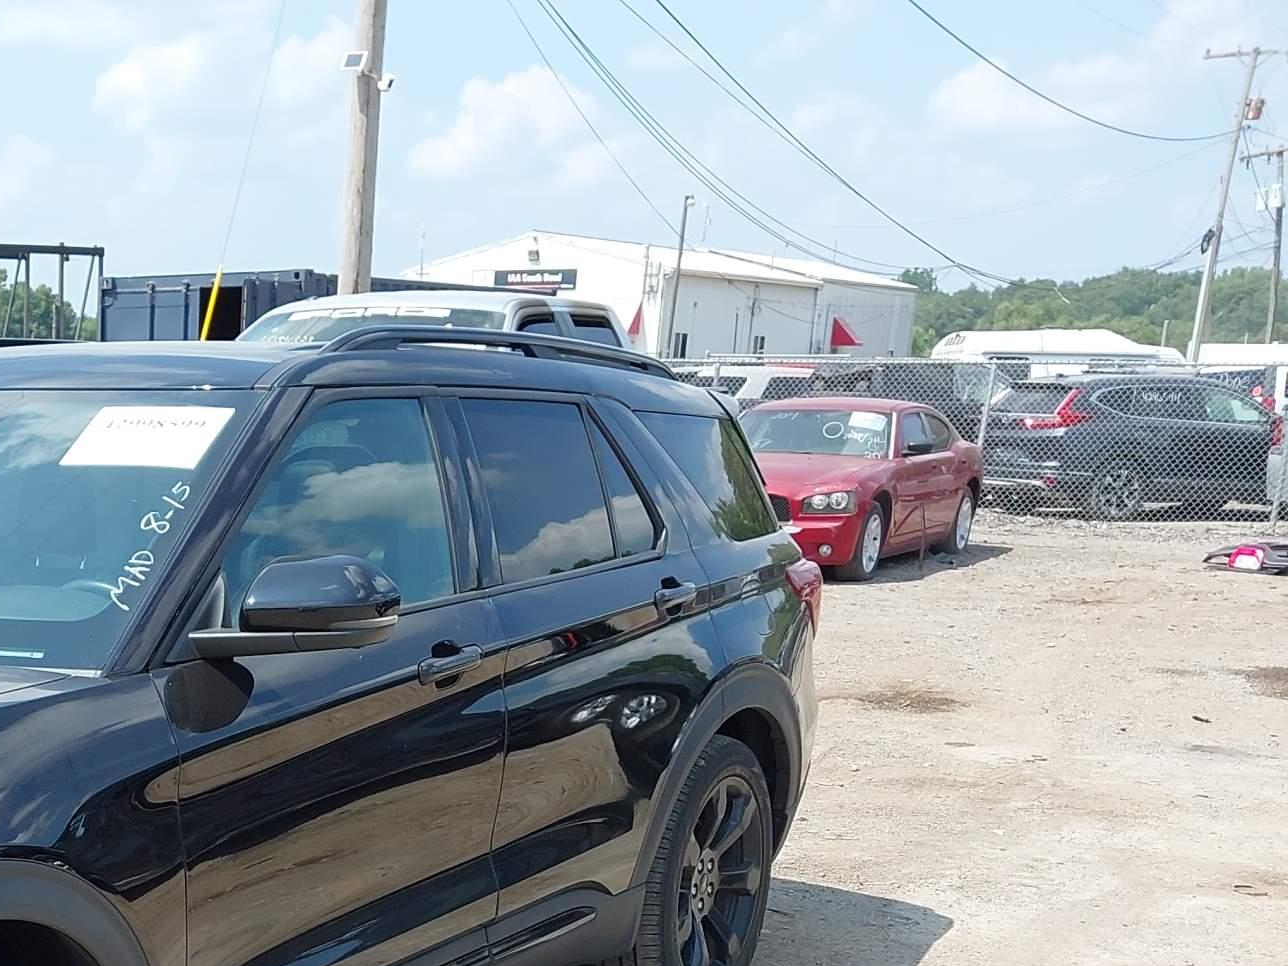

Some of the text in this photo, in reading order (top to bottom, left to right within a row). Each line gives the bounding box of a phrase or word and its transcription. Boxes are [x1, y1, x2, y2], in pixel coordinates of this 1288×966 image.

[288, 306, 452, 321] FORD
[110, 550, 155, 612] MAD
[140, 480, 191, 534] 8-15
